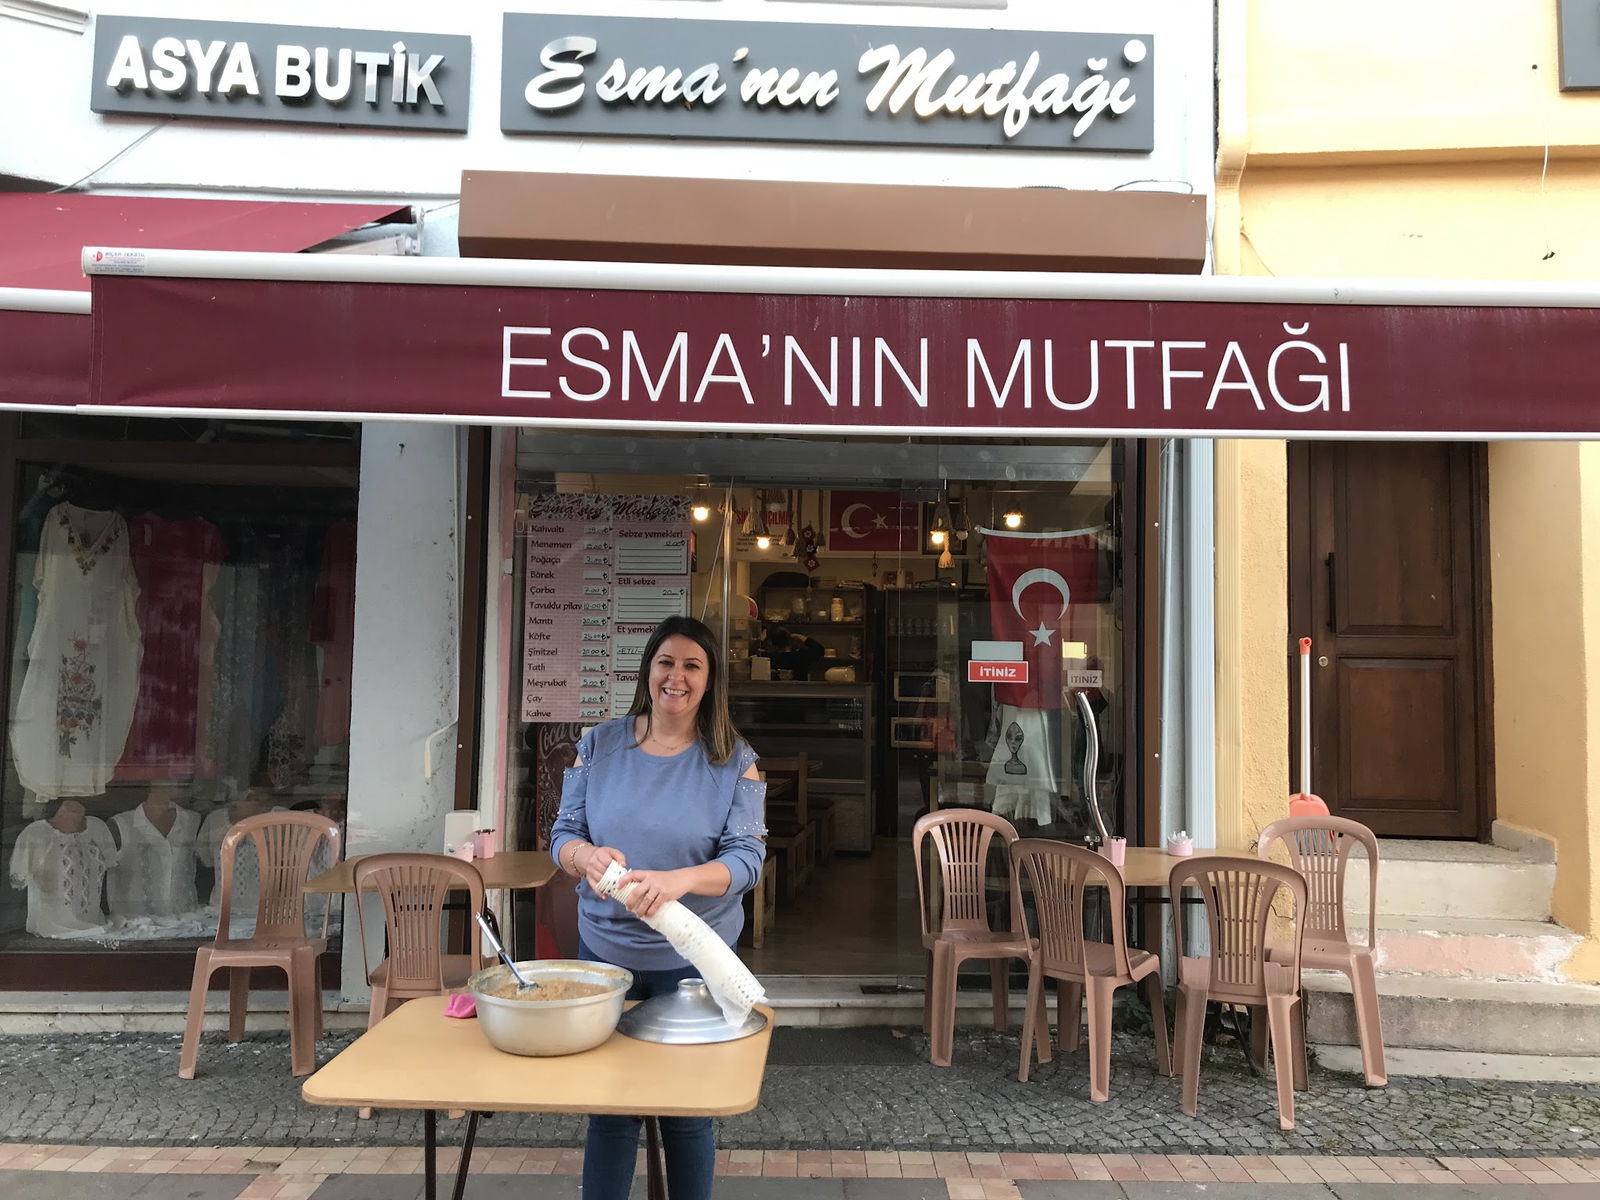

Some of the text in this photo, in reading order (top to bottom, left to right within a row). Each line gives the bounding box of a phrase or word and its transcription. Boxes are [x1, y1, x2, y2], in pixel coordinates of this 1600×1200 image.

[107, 35, 446, 108] ASYA BUTİK
[501, 322, 1351, 413] ESMA'NIN MUTFAĞI
[531, 525, 565, 533] Kahvaltı
[618, 529, 683, 539] Sebze yemekleri
[531, 541, 572, 549] Menemen
[530, 571, 555, 579] Börek
[633, 577, 656, 585] sebze
[530, 586, 556, 595] Çorba
[529, 602, 560, 610] Tavuklu
[563, 602, 582, 611] pilav
[529, 617, 553, 625] Mantı
[617, 625, 626, 633] Et
[528, 632, 551, 641] Köfte
[528, 648, 558, 657] Şinitzel
[979, 665, 1017, 677] İTİNİZ
[526, 679, 567, 688] Meşrubat
[526, 694, 543, 704] Çay
[526, 710, 552, 718] Kahve
